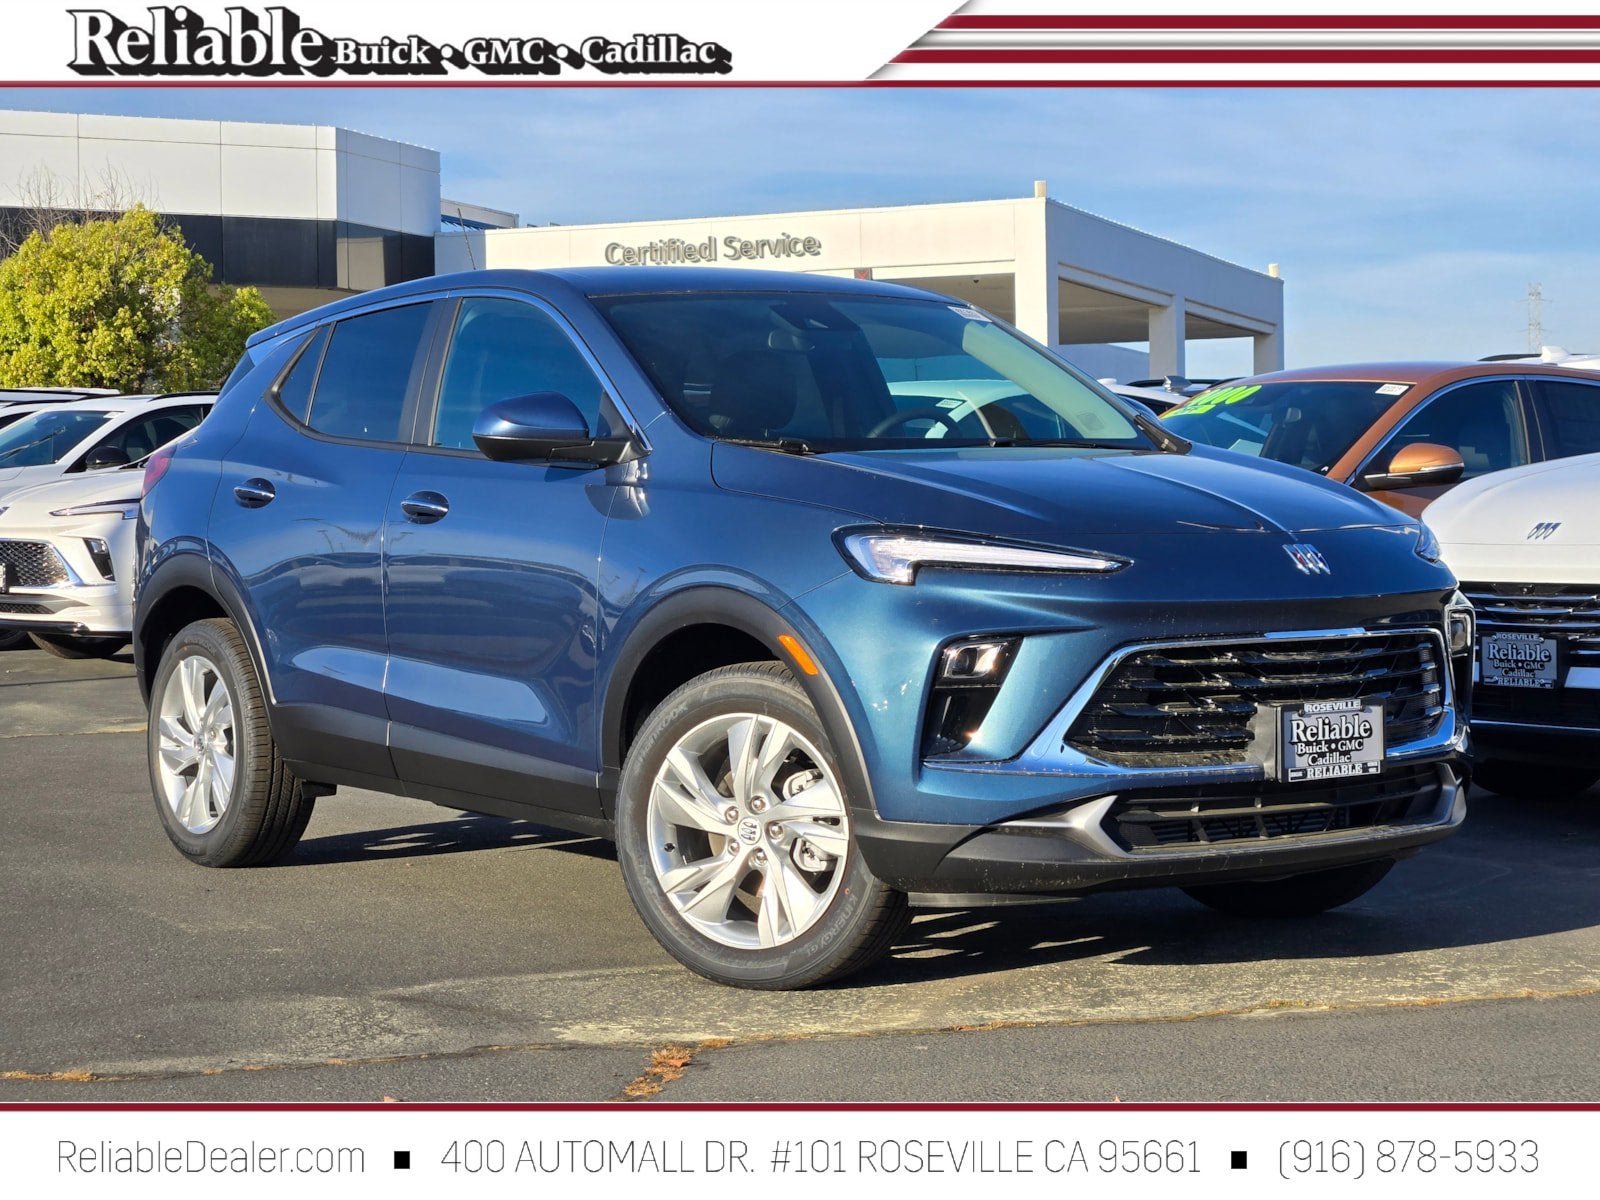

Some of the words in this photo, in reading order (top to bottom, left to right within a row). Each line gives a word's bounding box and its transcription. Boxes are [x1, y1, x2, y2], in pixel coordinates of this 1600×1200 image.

[604, 236, 717, 266] Certified
[723, 232, 822, 261] Service
[1488, 643, 1551, 662] Reliable
[1494, 660, 1517, 669] Buick
[1523, 661, 1545, 670] GMC
[1501, 667, 1536, 678] Cadillac
[1498, 678, 1541, 687] RELIABLE
[1306, 702, 1360, 712] ROSEVILLE
[1290, 714, 1373, 743] Reliable
[1296, 741, 1329, 756] Buick
[1337, 738, 1365, 751] GMC
[1307, 752, 1352, 766] Cadillac
[1307, 764, 1362, 778] RELIABLE
